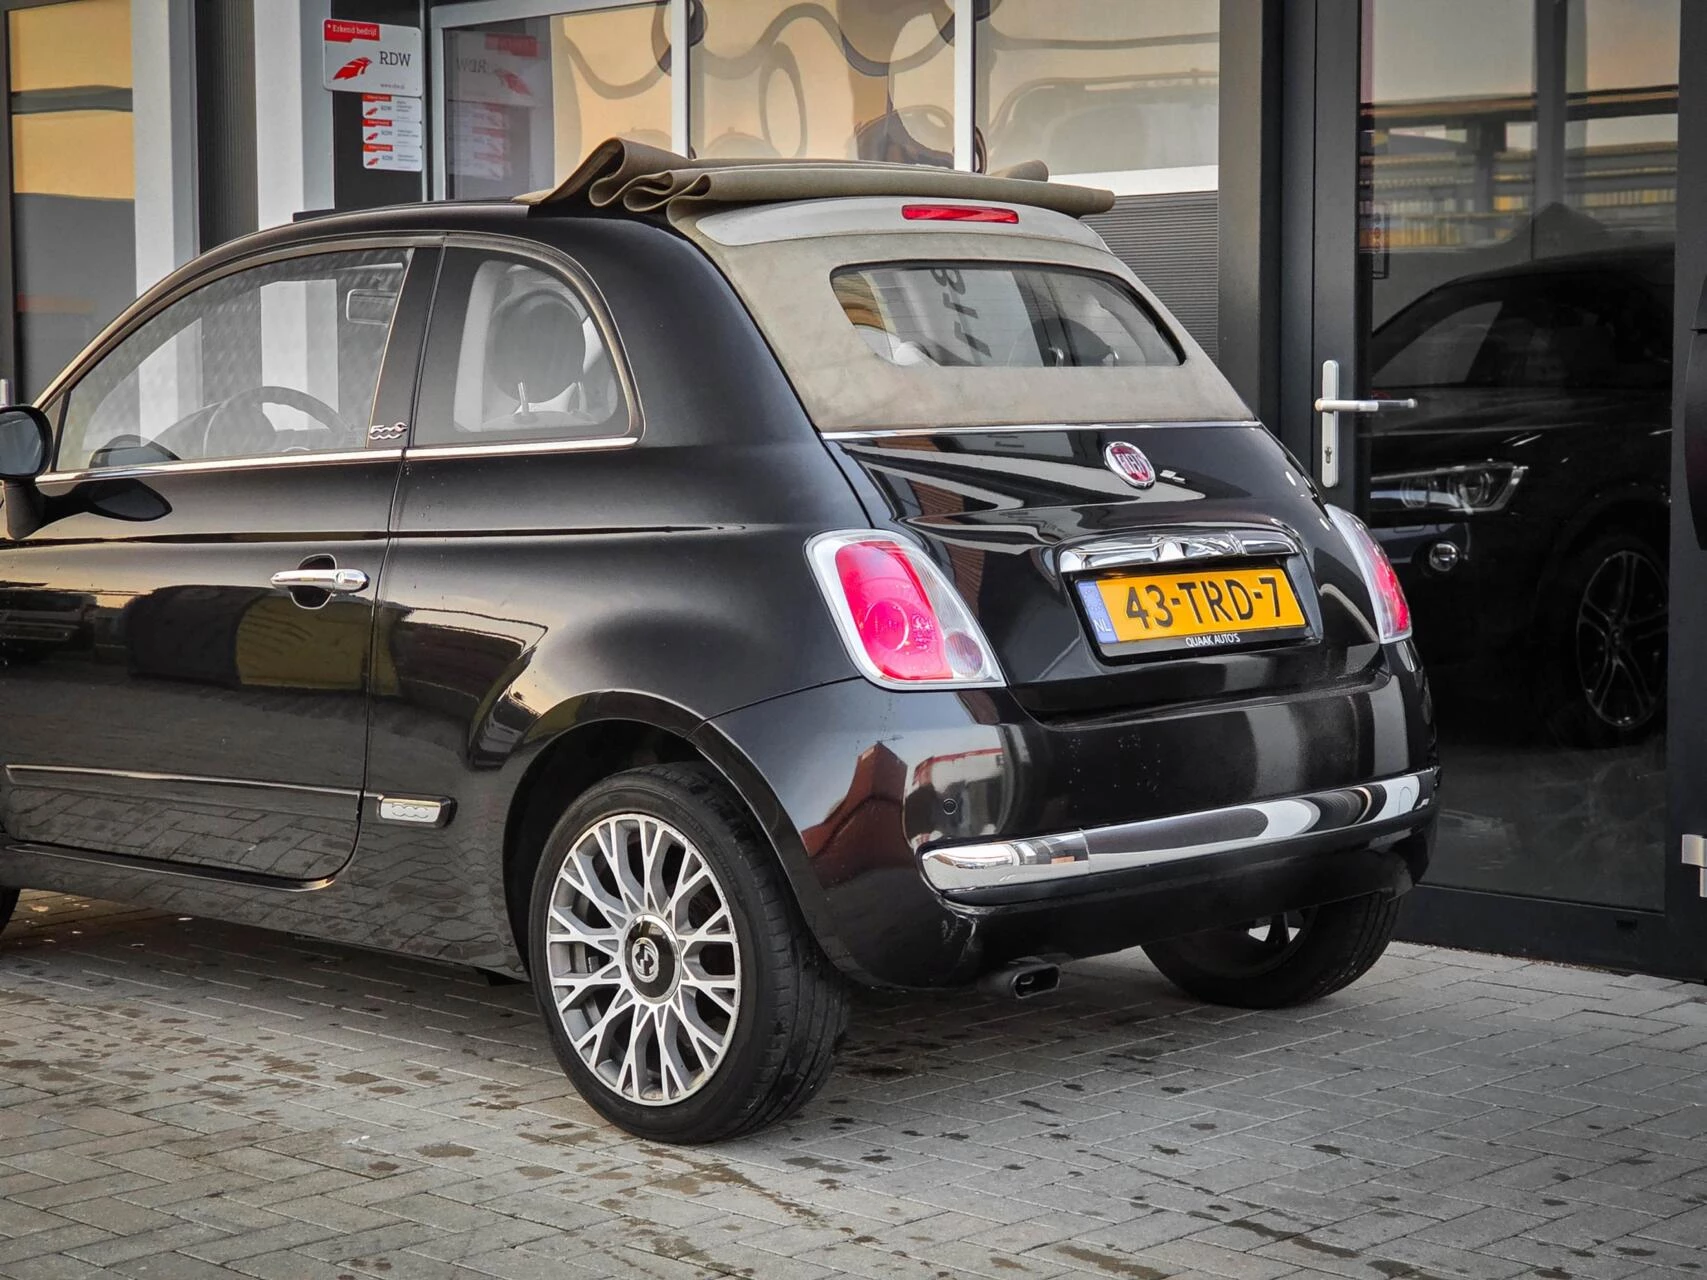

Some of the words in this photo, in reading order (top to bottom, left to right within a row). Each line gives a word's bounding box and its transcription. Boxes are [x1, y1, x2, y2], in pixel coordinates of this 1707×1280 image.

[379, 51, 411, 67] RDW
[1115, 453, 1146, 475] FIAT
[1126, 576, 1281, 629] 43-TRD-7
[1093, 619, 1111, 633] NL
[1185, 637, 1214, 647] QUAAK
[1214, 633, 1241, 644] AUTO'S
